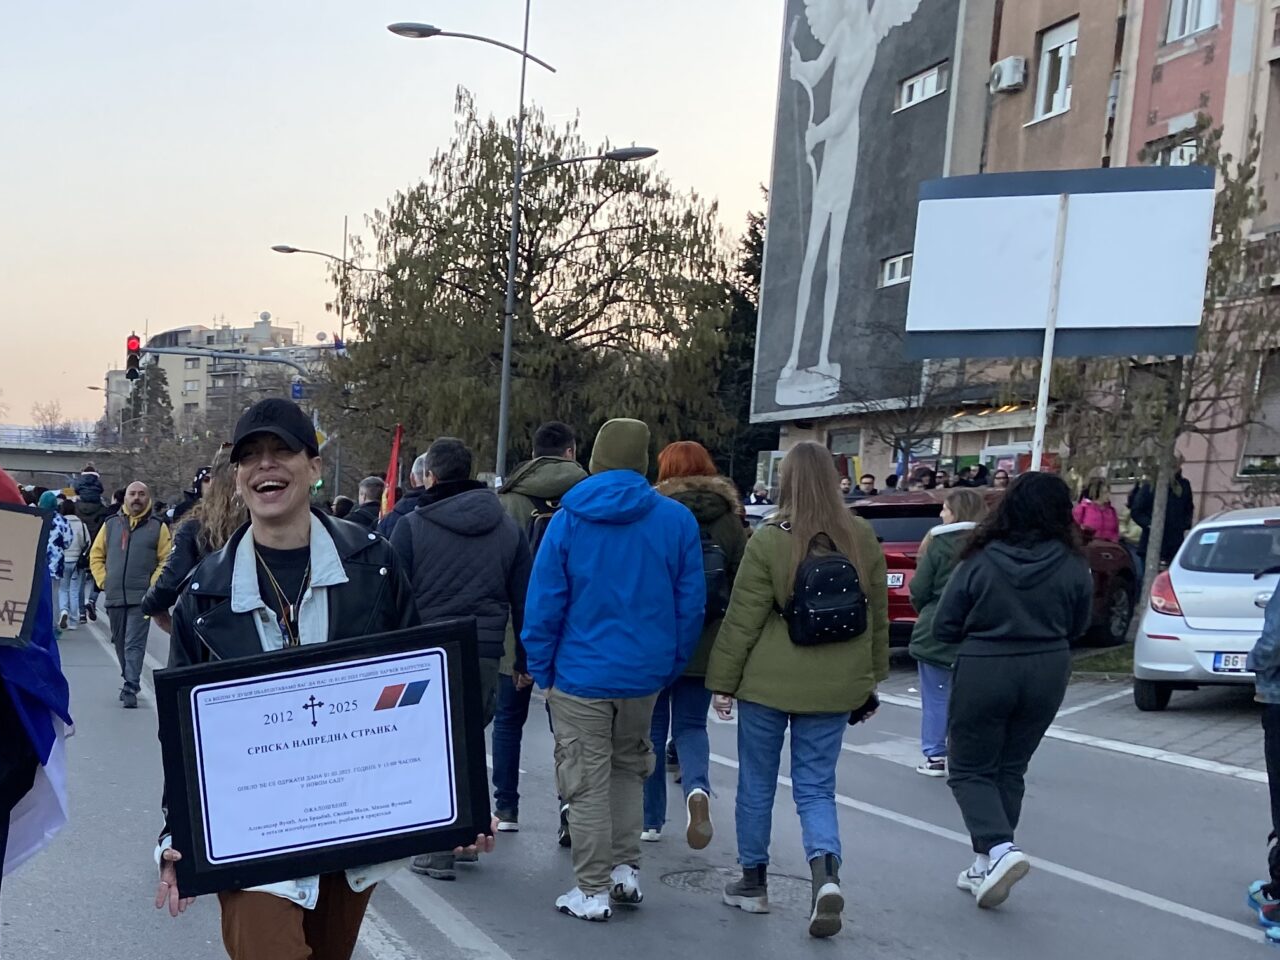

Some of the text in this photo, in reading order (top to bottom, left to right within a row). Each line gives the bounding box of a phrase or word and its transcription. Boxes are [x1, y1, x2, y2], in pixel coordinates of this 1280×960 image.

[1224, 656, 1238, 666] BG
[263, 700, 358, 726] 2012 2025
[247, 724, 398, 757] СРПСКА НАПРЕДНА СТРАНКА
